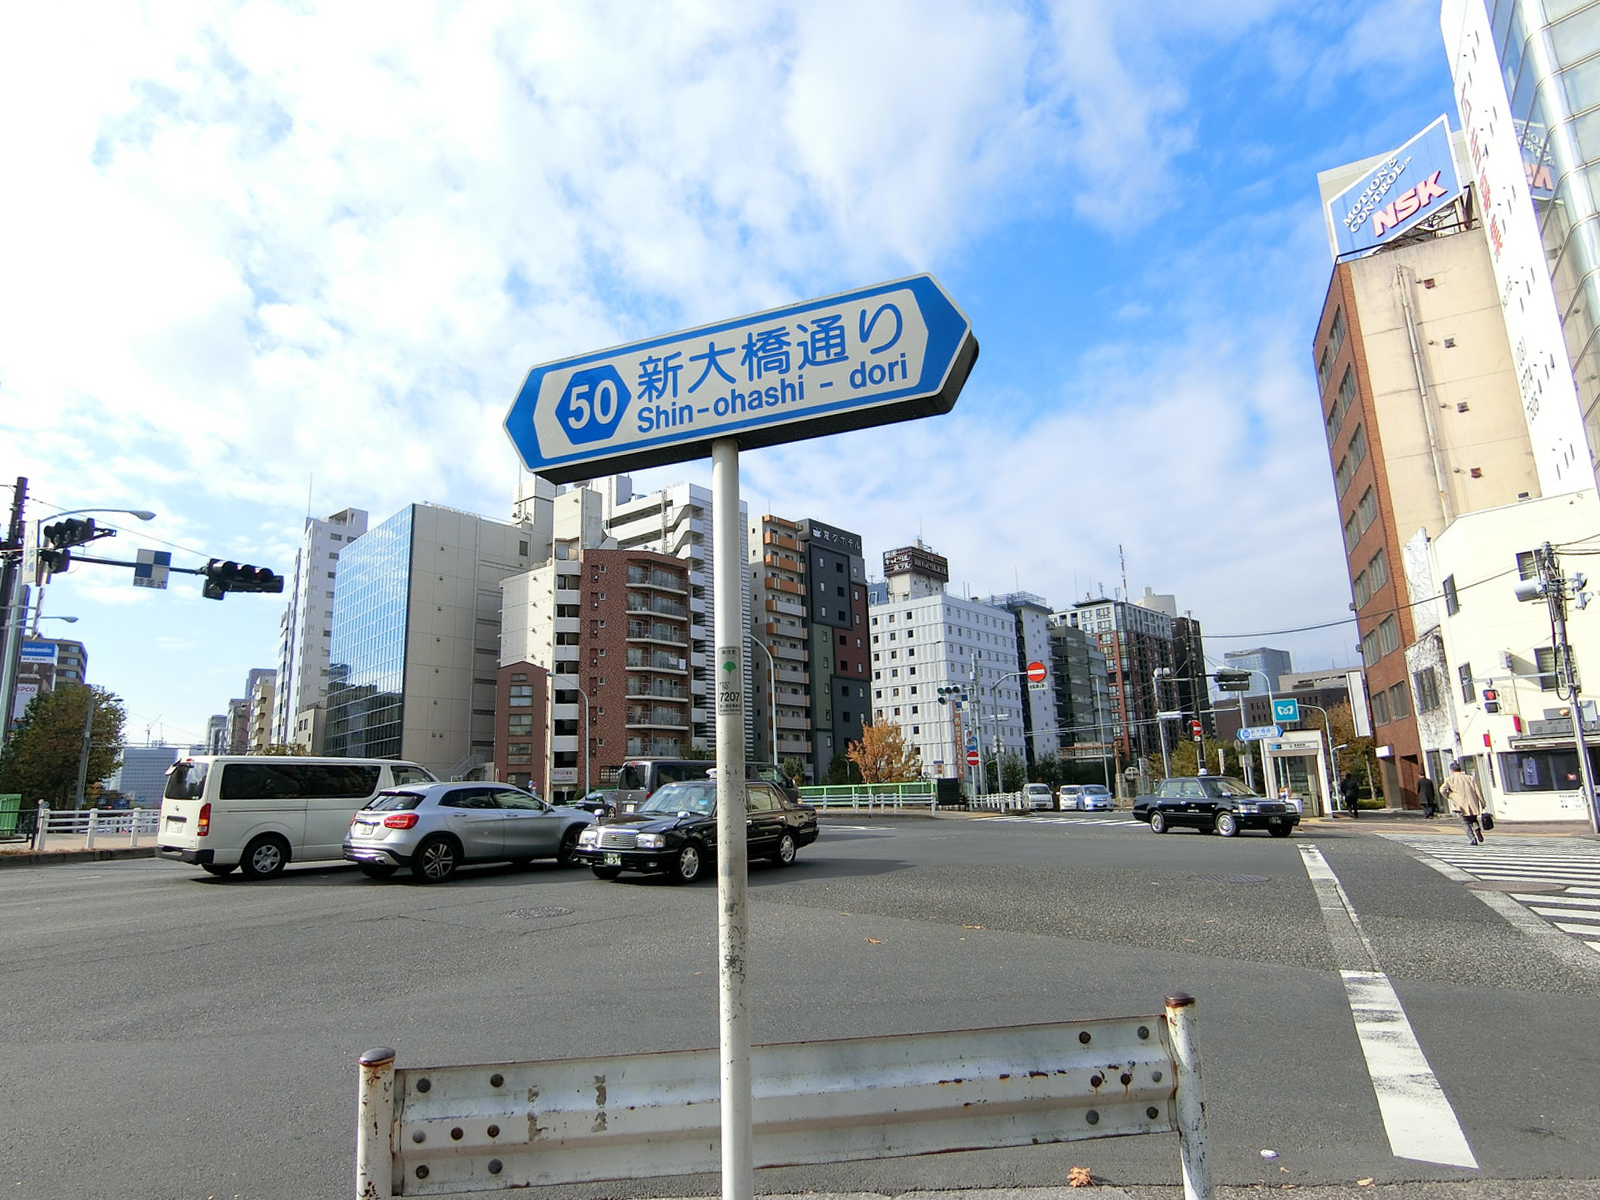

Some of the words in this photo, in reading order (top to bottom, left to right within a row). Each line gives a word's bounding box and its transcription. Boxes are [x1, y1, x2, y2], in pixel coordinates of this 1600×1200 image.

[1342, 166, 1390, 228] MOTION
[1387, 157, 1399, 168] &
[1350, 164, 1406, 233] CONTROL
[1371, 170, 1448, 237] NSK
[636, 303, 904, 404] 新大橋通り
[567, 378, 619, 429] 50
[636, 374, 805, 433] Shin-ohashi
[849, 353, 908, 390] dori
[720, 691, 741, 702] 7207
